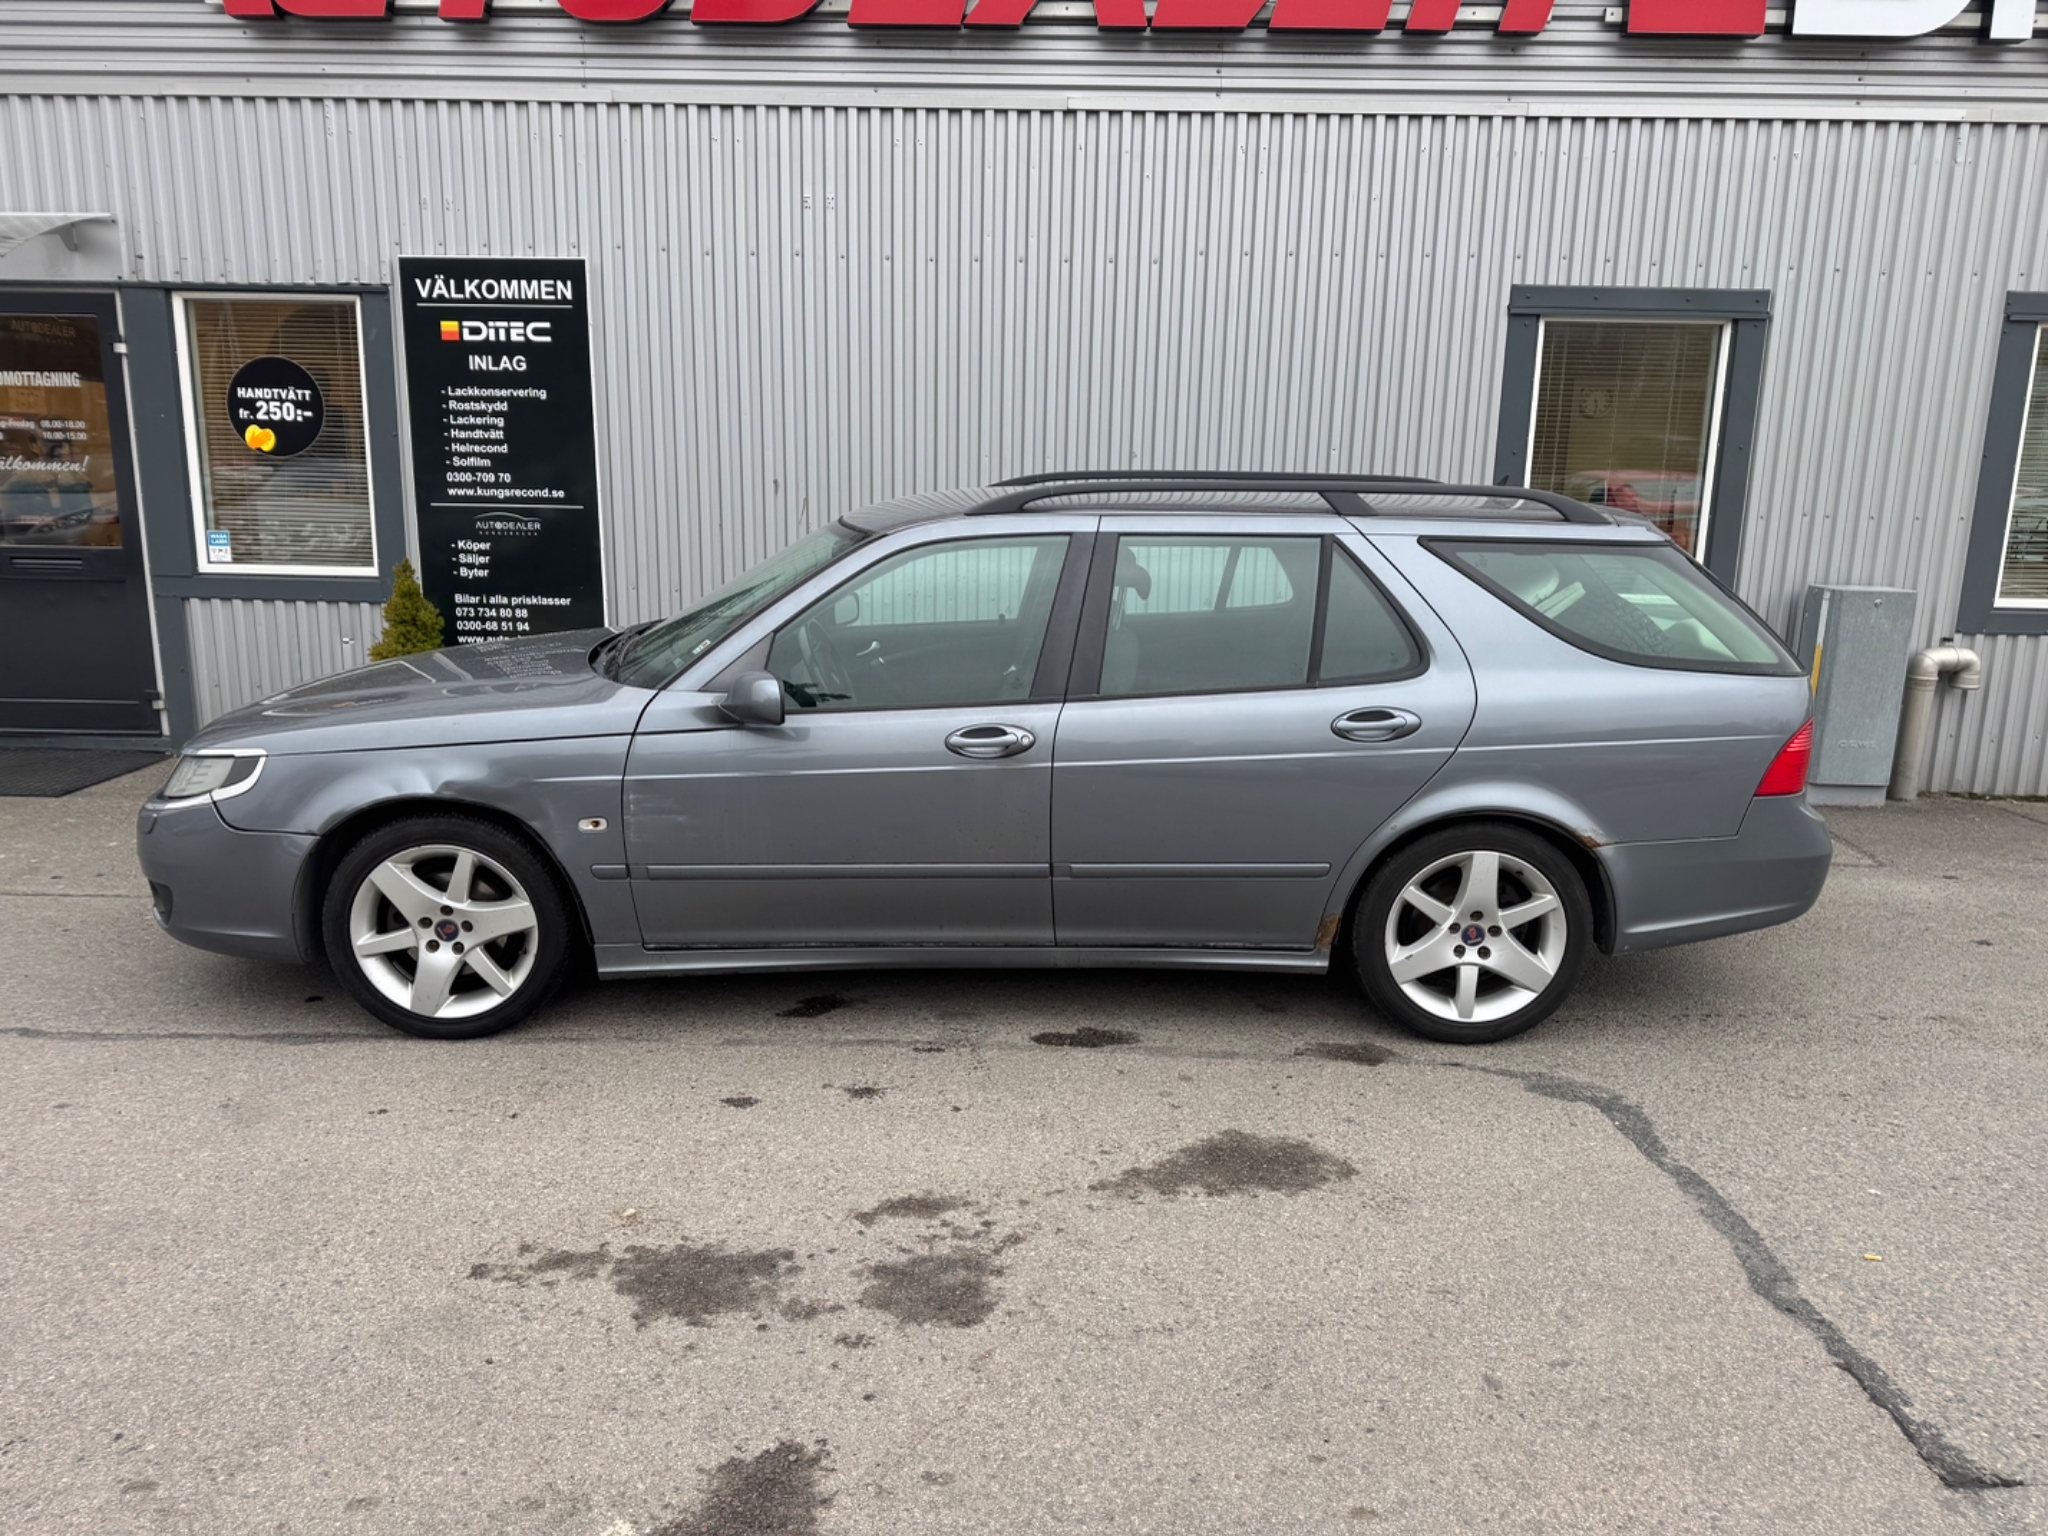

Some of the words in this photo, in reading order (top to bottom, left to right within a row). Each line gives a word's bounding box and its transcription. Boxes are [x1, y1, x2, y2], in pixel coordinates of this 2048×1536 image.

[415, 275, 572, 300] VÄLKOMMEN
[469, 355, 526, 371] INLAG
[237, 387, 311, 401] HANDTVÄTT
[448, 386, 547, 400] Lackkonservering
[239, 408, 254, 420] fr.
[256, 399, 312, 421] 250:-
[449, 400, 508, 414] Rostskydd
[450, 415, 505, 428] Lackering
[451, 429, 504, 440] Handtvätt
[452, 443, 509, 454] Helrecond
[453, 456, 492, 467] Solfilm
[447, 472, 496, 483] 0300-709
[498, 473, 512, 483] 70
[447, 487, 565, 500] www.kungsrecond.se
[475, 521, 542, 531] AUTODEALER
[458, 540, 491, 552] Köper
[459, 553, 490, 566] Säljer
[460, 567, 490, 579] Byter
[455, 594, 481, 604] Bilar
[489, 595, 509, 605] alla
[512, 596, 572, 607] prisklasser
[456, 607, 476, 618] 073
[478, 608, 498, 618] 734
[500, 608, 513, 618] 80
[515, 608, 529, 619] 88
[457, 621, 499, 632] 0300-68
[502, 621, 513, 632] 51
[516, 622, 530, 632] 94
